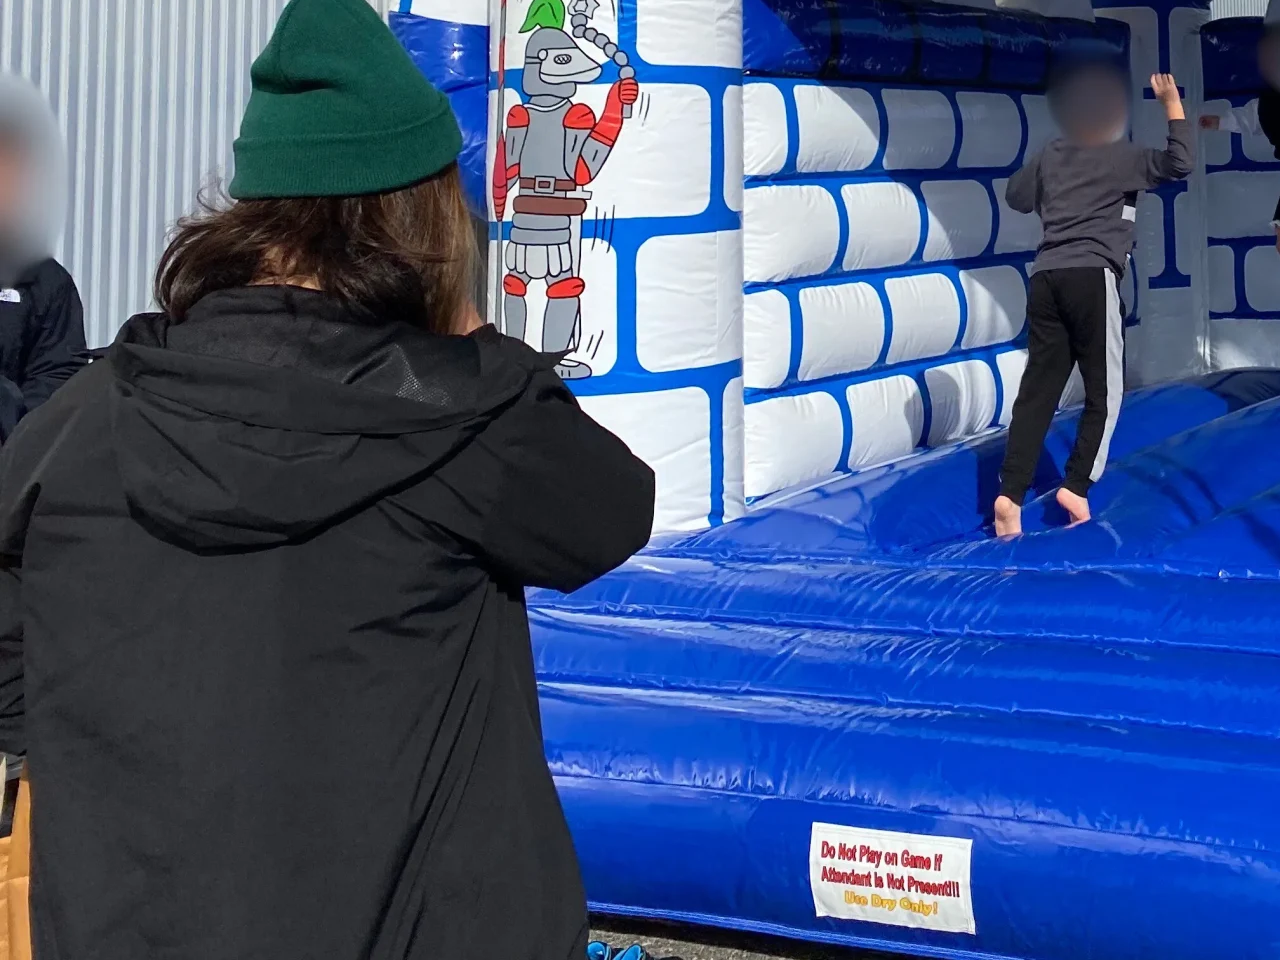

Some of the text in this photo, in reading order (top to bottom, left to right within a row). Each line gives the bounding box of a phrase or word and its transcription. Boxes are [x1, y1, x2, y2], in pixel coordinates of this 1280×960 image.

[821, 841, 943, 871] Do Not Play on Game If
[886, 873, 905, 891] Not
[845, 891, 868, 906] Use
[871, 894, 896, 912] Dry
